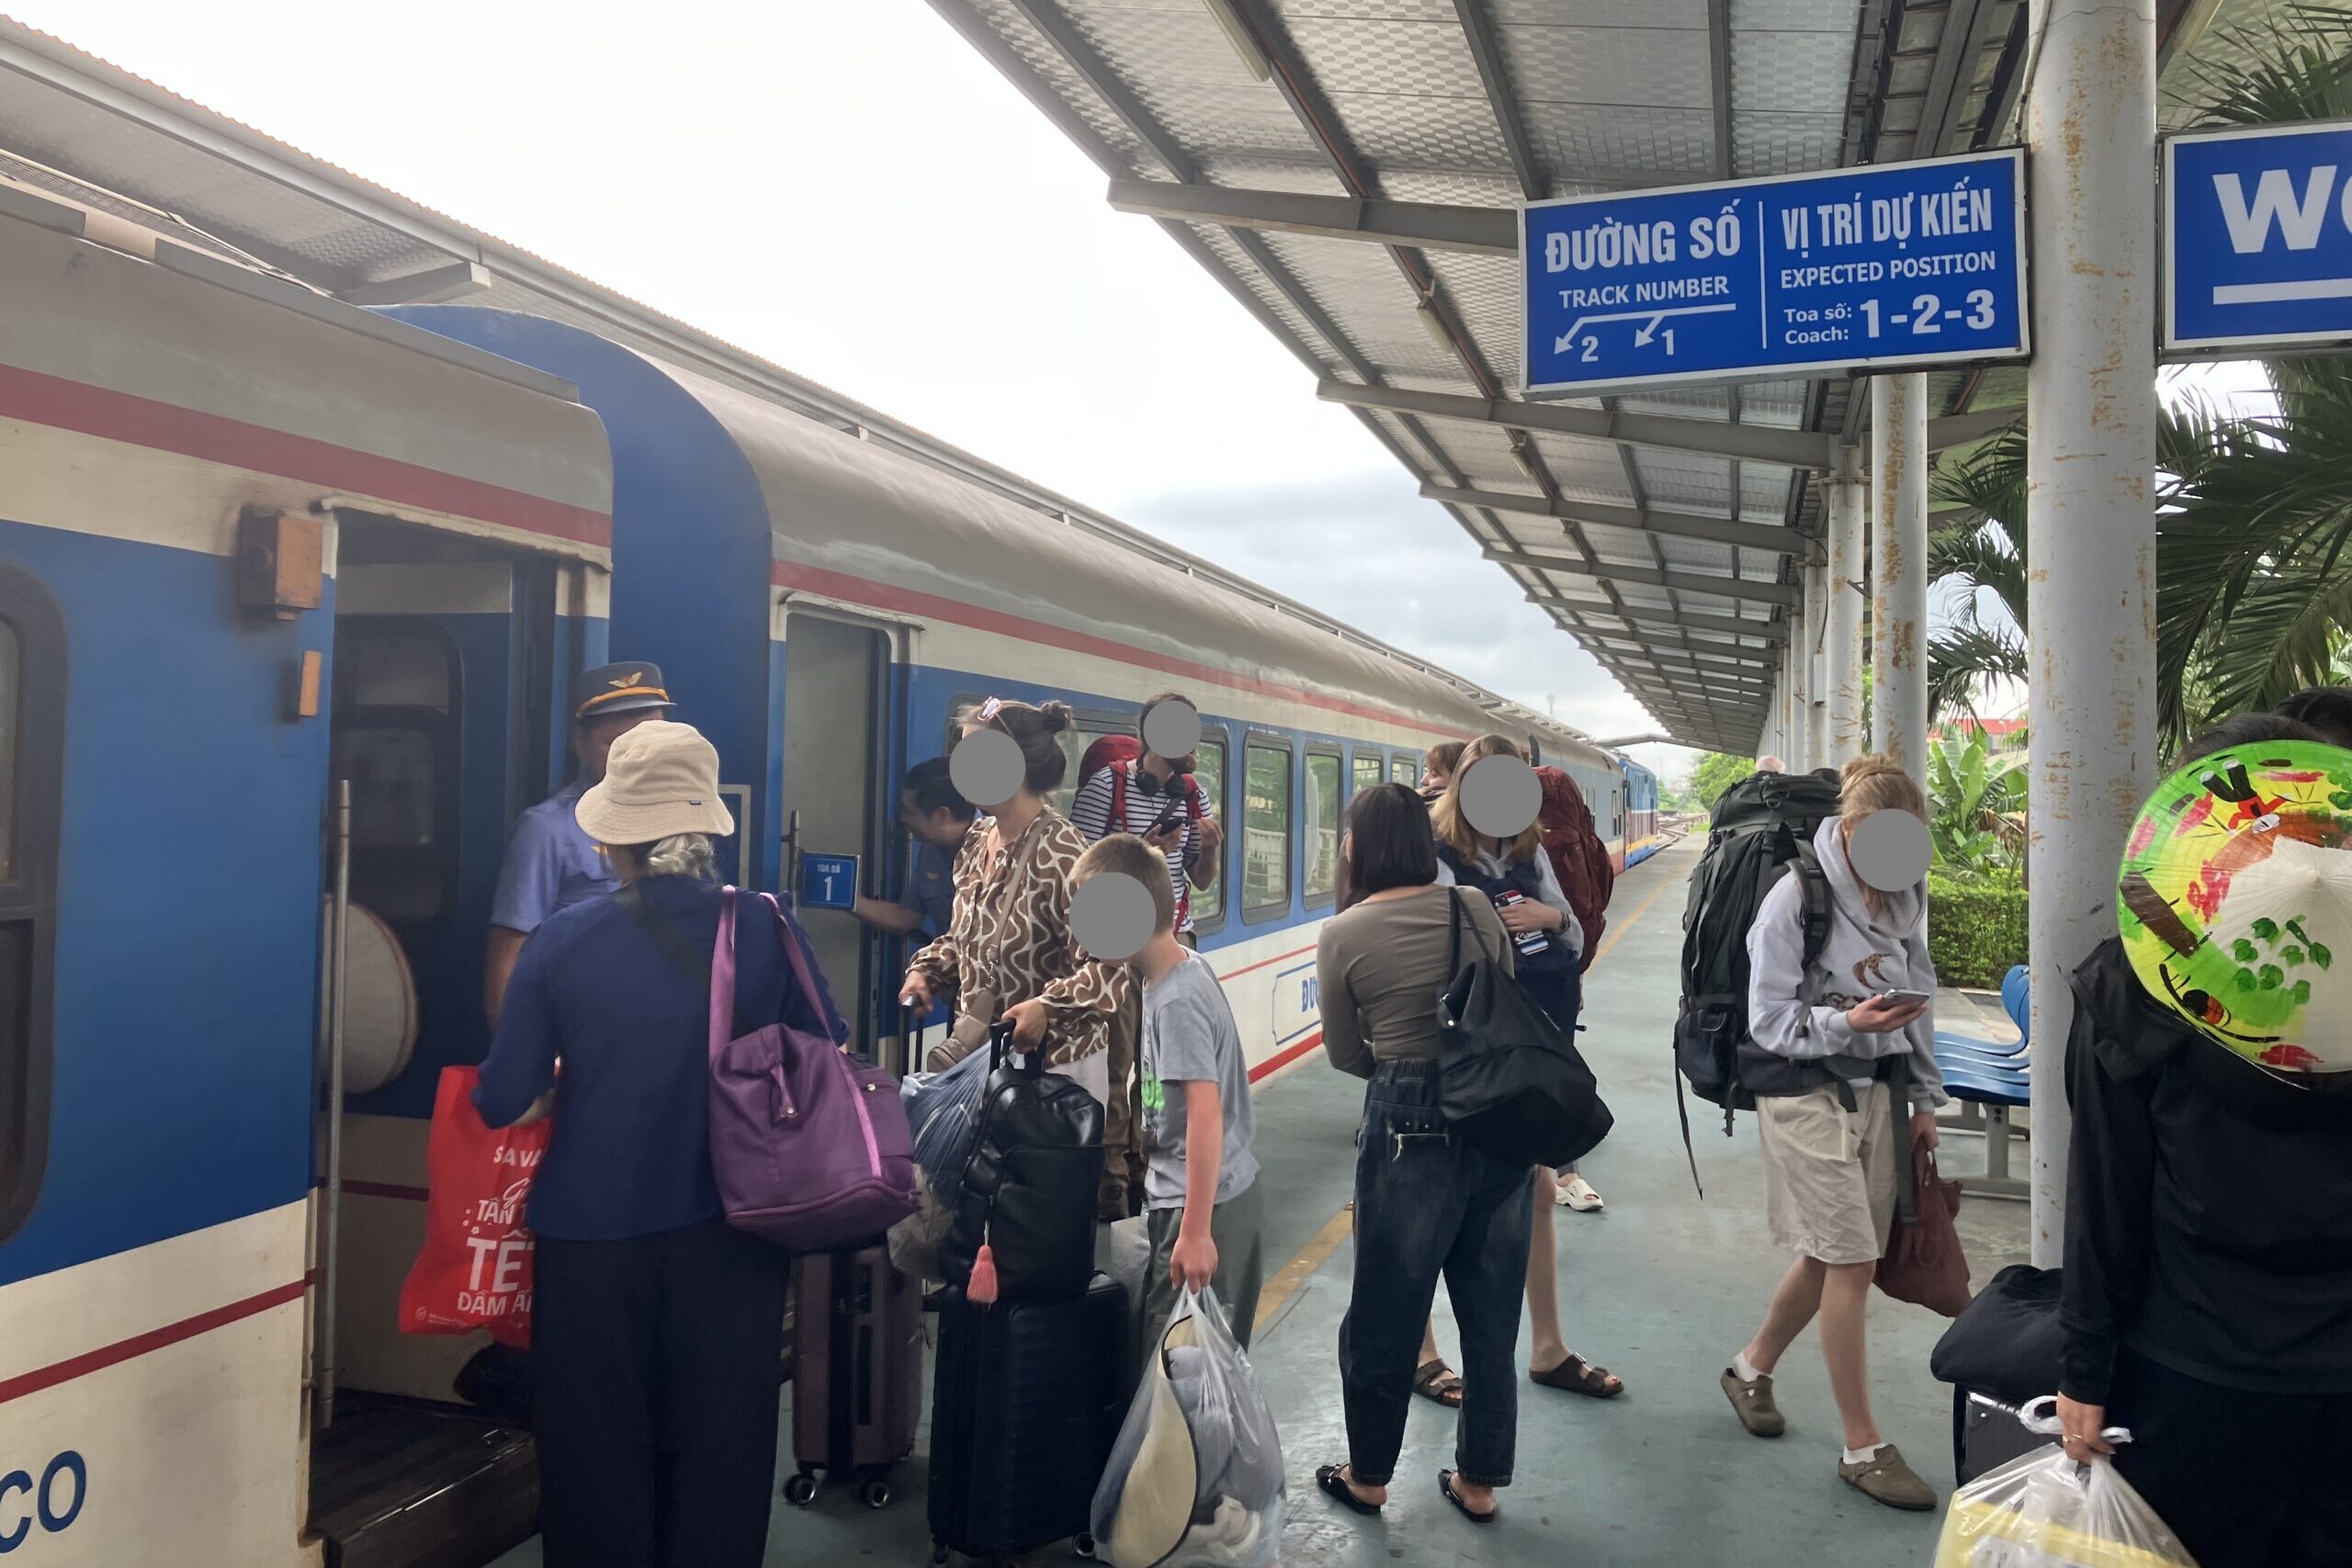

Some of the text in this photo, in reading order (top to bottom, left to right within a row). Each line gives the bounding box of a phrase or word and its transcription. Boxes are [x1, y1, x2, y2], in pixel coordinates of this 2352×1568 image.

[1781, 175, 1993, 258] VỊ TRÍ DỰ KIẾN
[2212, 164, 2352, 254] W
[1544, 198, 1741, 273] ĐƯỜNG SỐ
[1781, 251, 1996, 289] EXPECTED POSITION
[1559, 276, 1729, 309] TRACK NUMBER
[1784, 301, 1853, 323] Toa số:
[1860, 289, 1996, 339] 1-2-3
[1581, 329, 1675, 363] 2 1
[1785, 326, 1850, 345] Coach:
[824, 875, 832, 902] 1
[477, 1197, 514, 1226] TẬN
[467, 1228, 535, 1292] TẾ
